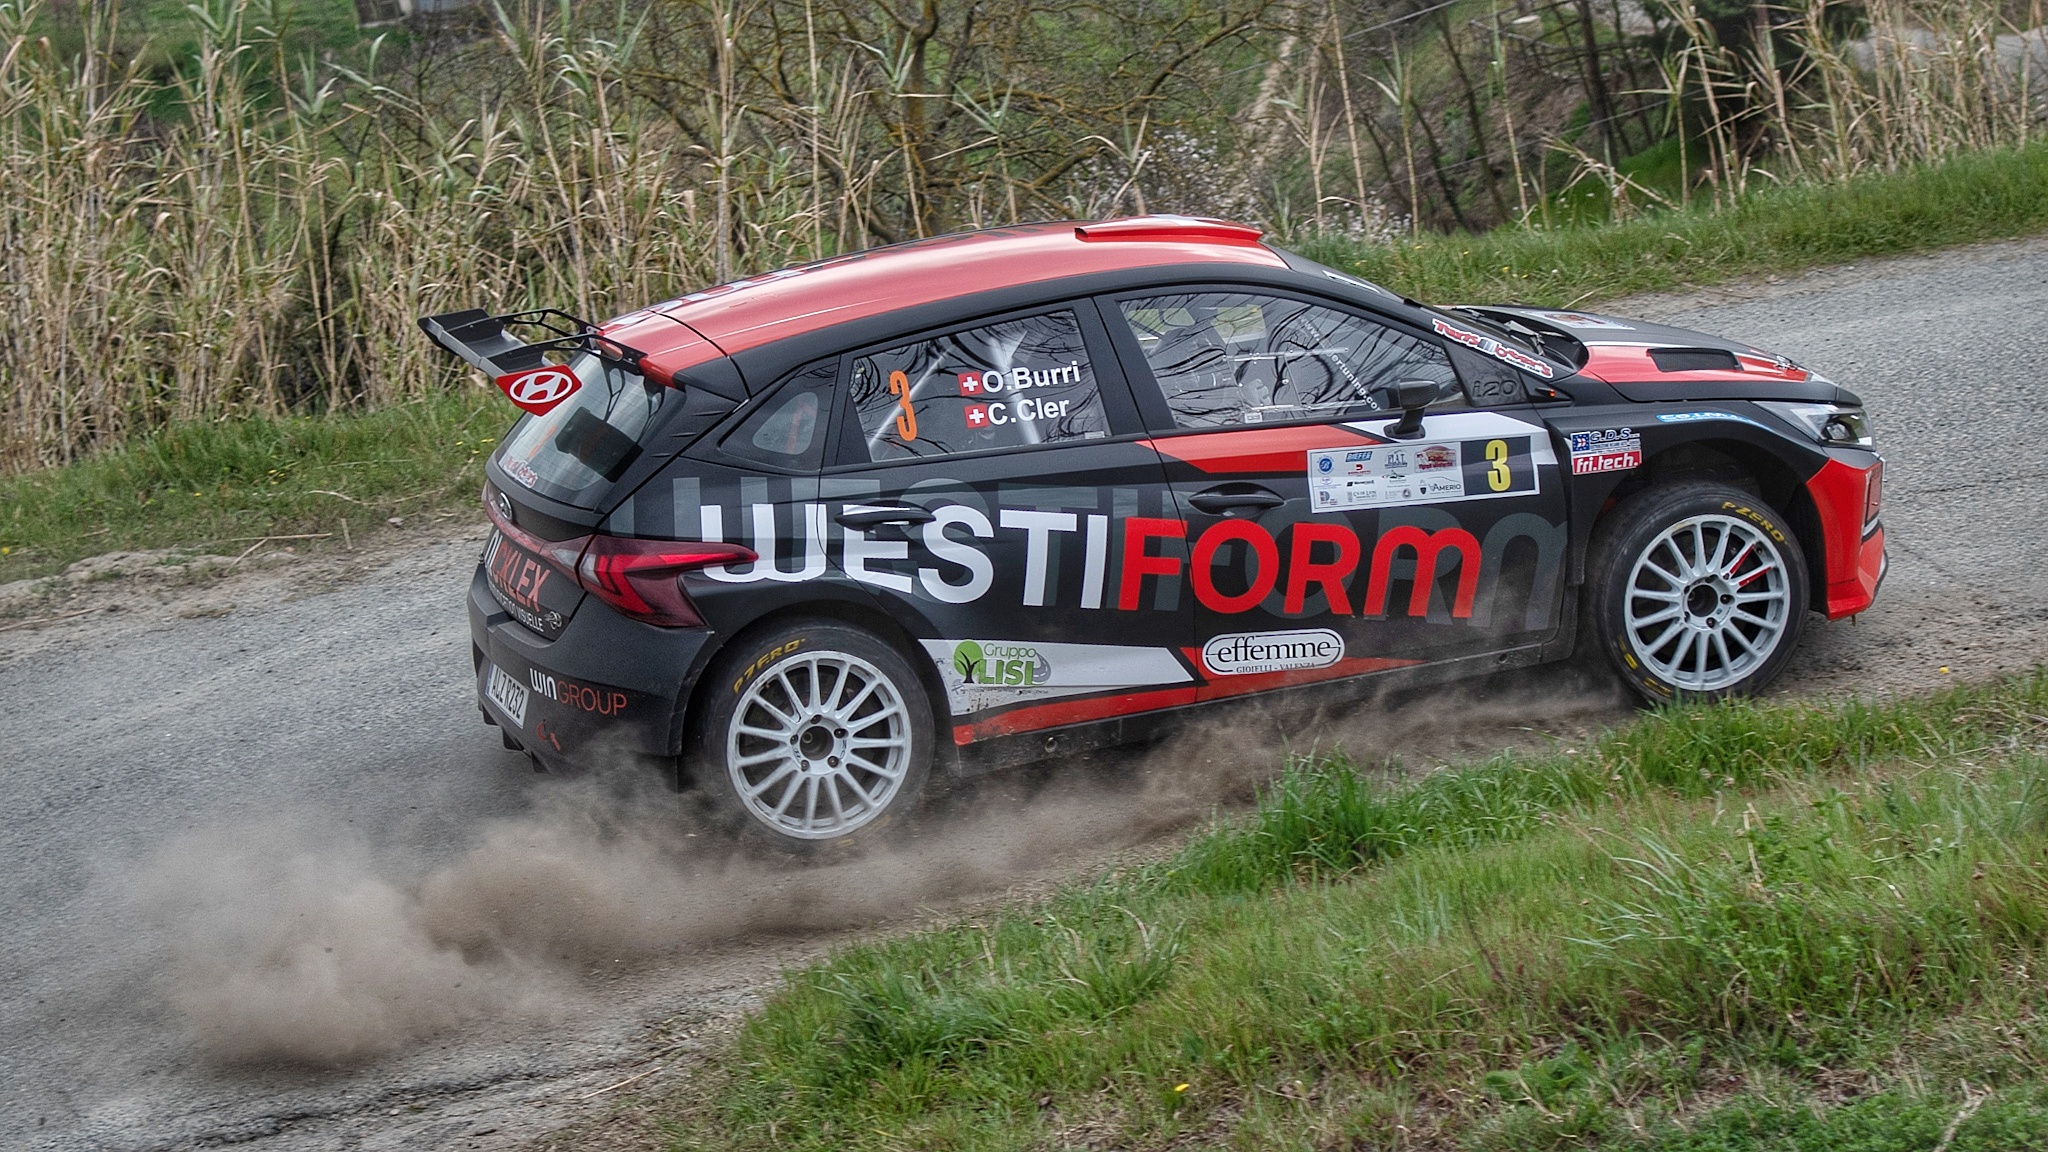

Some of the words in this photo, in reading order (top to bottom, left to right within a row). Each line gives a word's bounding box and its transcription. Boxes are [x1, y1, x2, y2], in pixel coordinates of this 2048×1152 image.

[982, 361, 1081, 393] O.Burri
[1472, 380, 1519, 397] i20
[889, 370, 918, 442] 3
[987, 398, 1069, 425] C.Cler
[1485, 439, 1512, 492] 3
[1576, 453, 1639, 473] fri.tech.
[700, 503, 1482, 619] WESTIFORM
[983, 643, 1037, 659] Gruppo
[1218, 635, 1331, 663] effemme
[978, 659, 1035, 686] LISI
[1236, 664, 1272, 674] GIOIELLI
[1279, 661, 1316, 671] VALENZA
